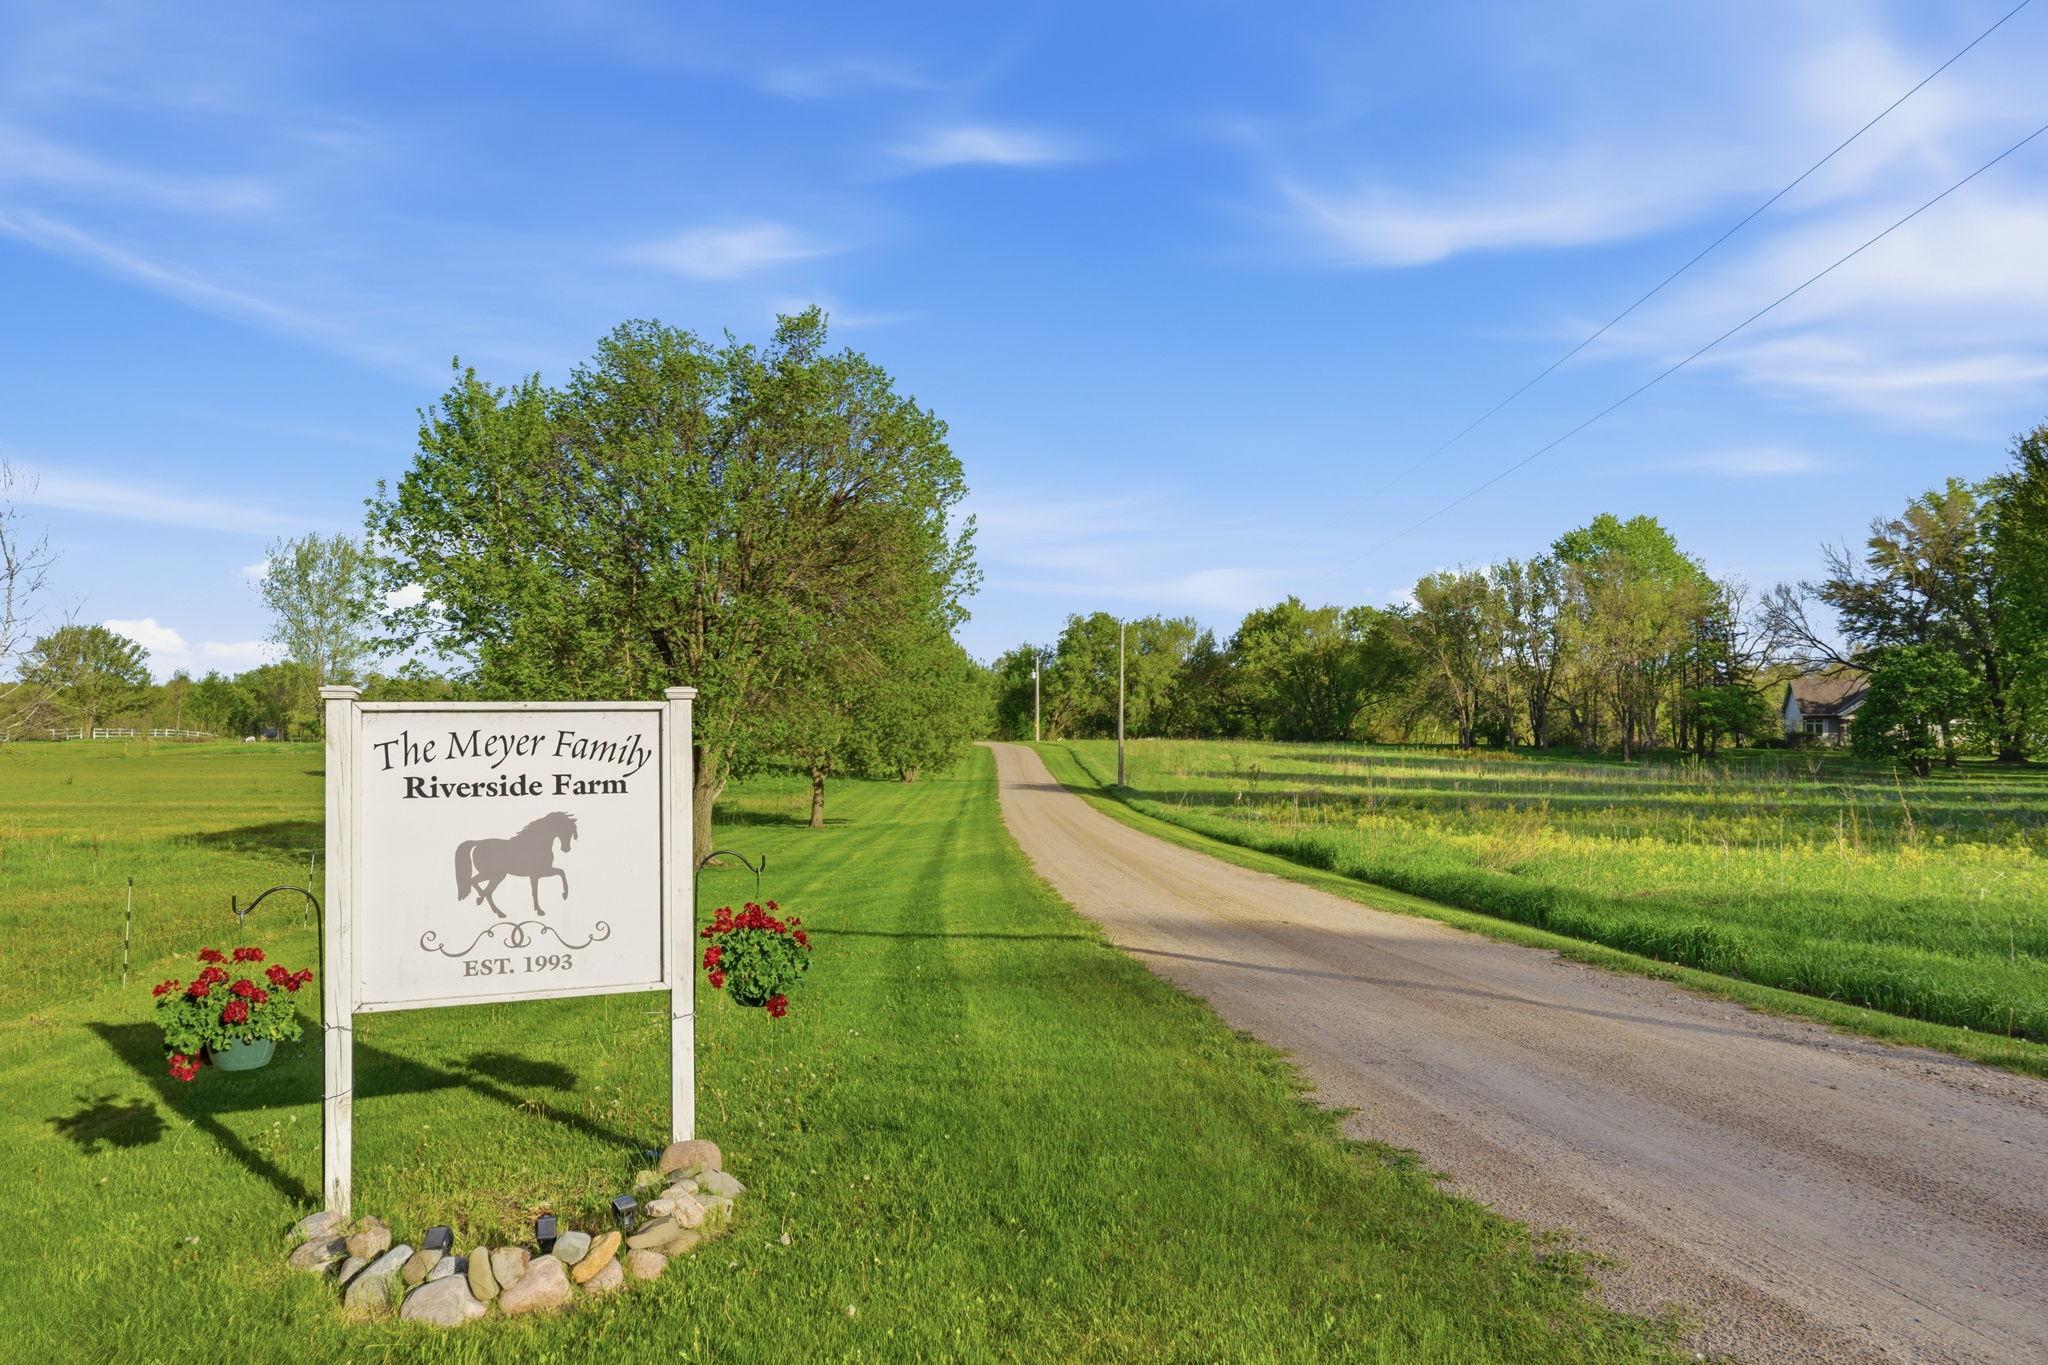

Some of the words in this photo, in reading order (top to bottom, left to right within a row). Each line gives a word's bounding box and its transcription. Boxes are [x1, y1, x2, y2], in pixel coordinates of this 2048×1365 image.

[373, 730, 437, 771] The
[445, 728, 546, 769] Meyer
[552, 730, 652, 778] Family
[402, 774, 543, 799] Riverside
[552, 773, 629, 796] Farm
[462, 957, 515, 977] EST.
[523, 953, 573, 973] 1993
